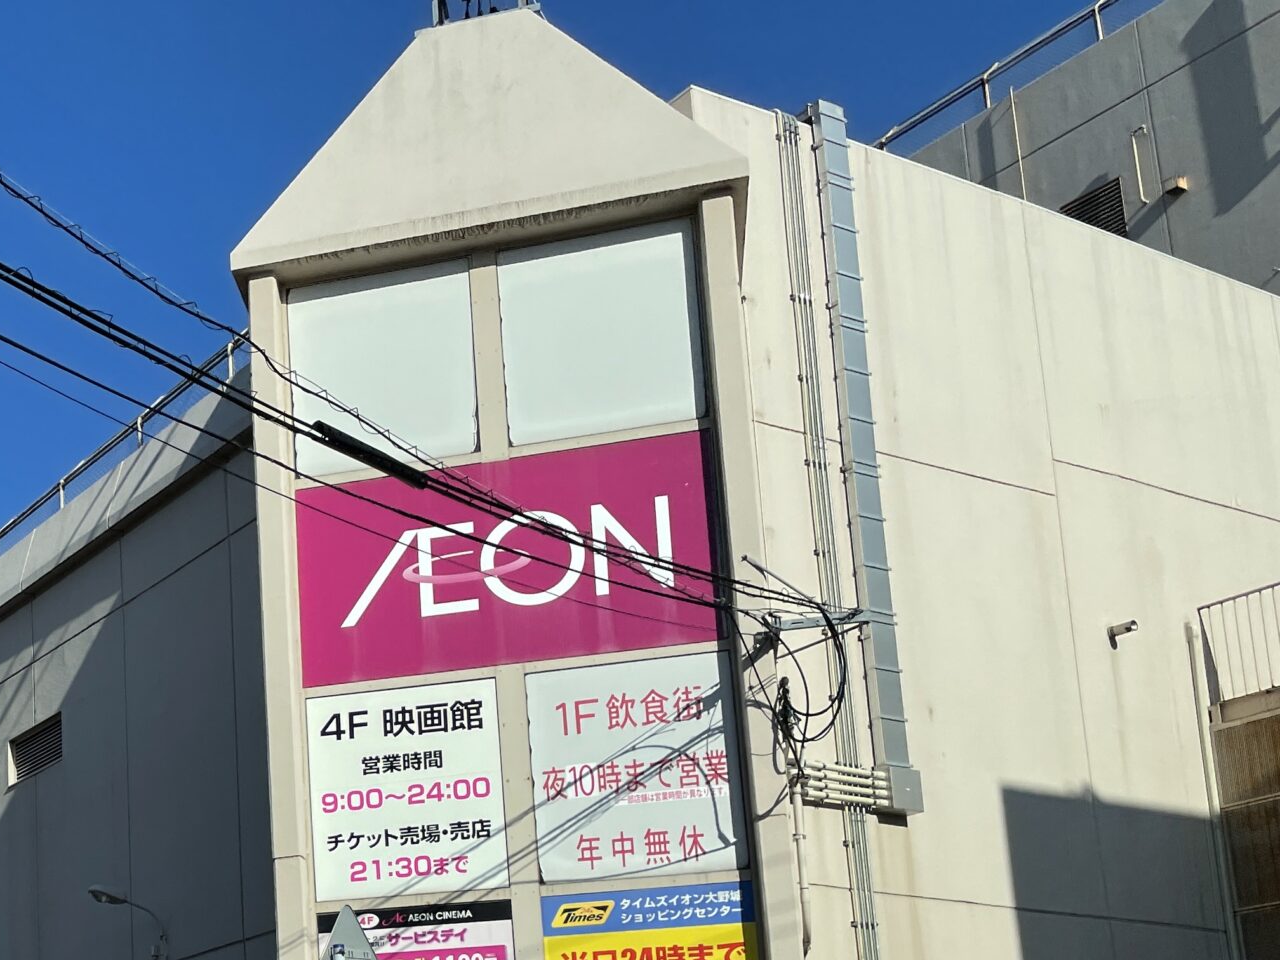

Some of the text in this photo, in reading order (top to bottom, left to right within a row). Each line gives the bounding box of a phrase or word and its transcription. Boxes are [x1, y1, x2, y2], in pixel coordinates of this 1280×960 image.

[340, 495, 675, 628] AEON
[320, 699, 484, 741] 4F 映画館
[555, 686, 704, 736] 1F 飲食街
[361, 750, 443, 776] 営業時間
[542, 749, 730, 801] 夜10時まで営業
[327, 819, 492, 852] チケット売場・売店
[576, 824, 706, 870] 年中無休
[350, 855, 469, 883] 21:30まで
[620, 890, 743, 910] タイムズイオン大野城
[408, 913, 433, 922] AEON
[435, 910, 473, 920] CINEMA
[560, 905, 609, 924] Times
[621, 907, 744, 925] ショッピングセンター
[387, 928, 468, 946] サービスデイ
